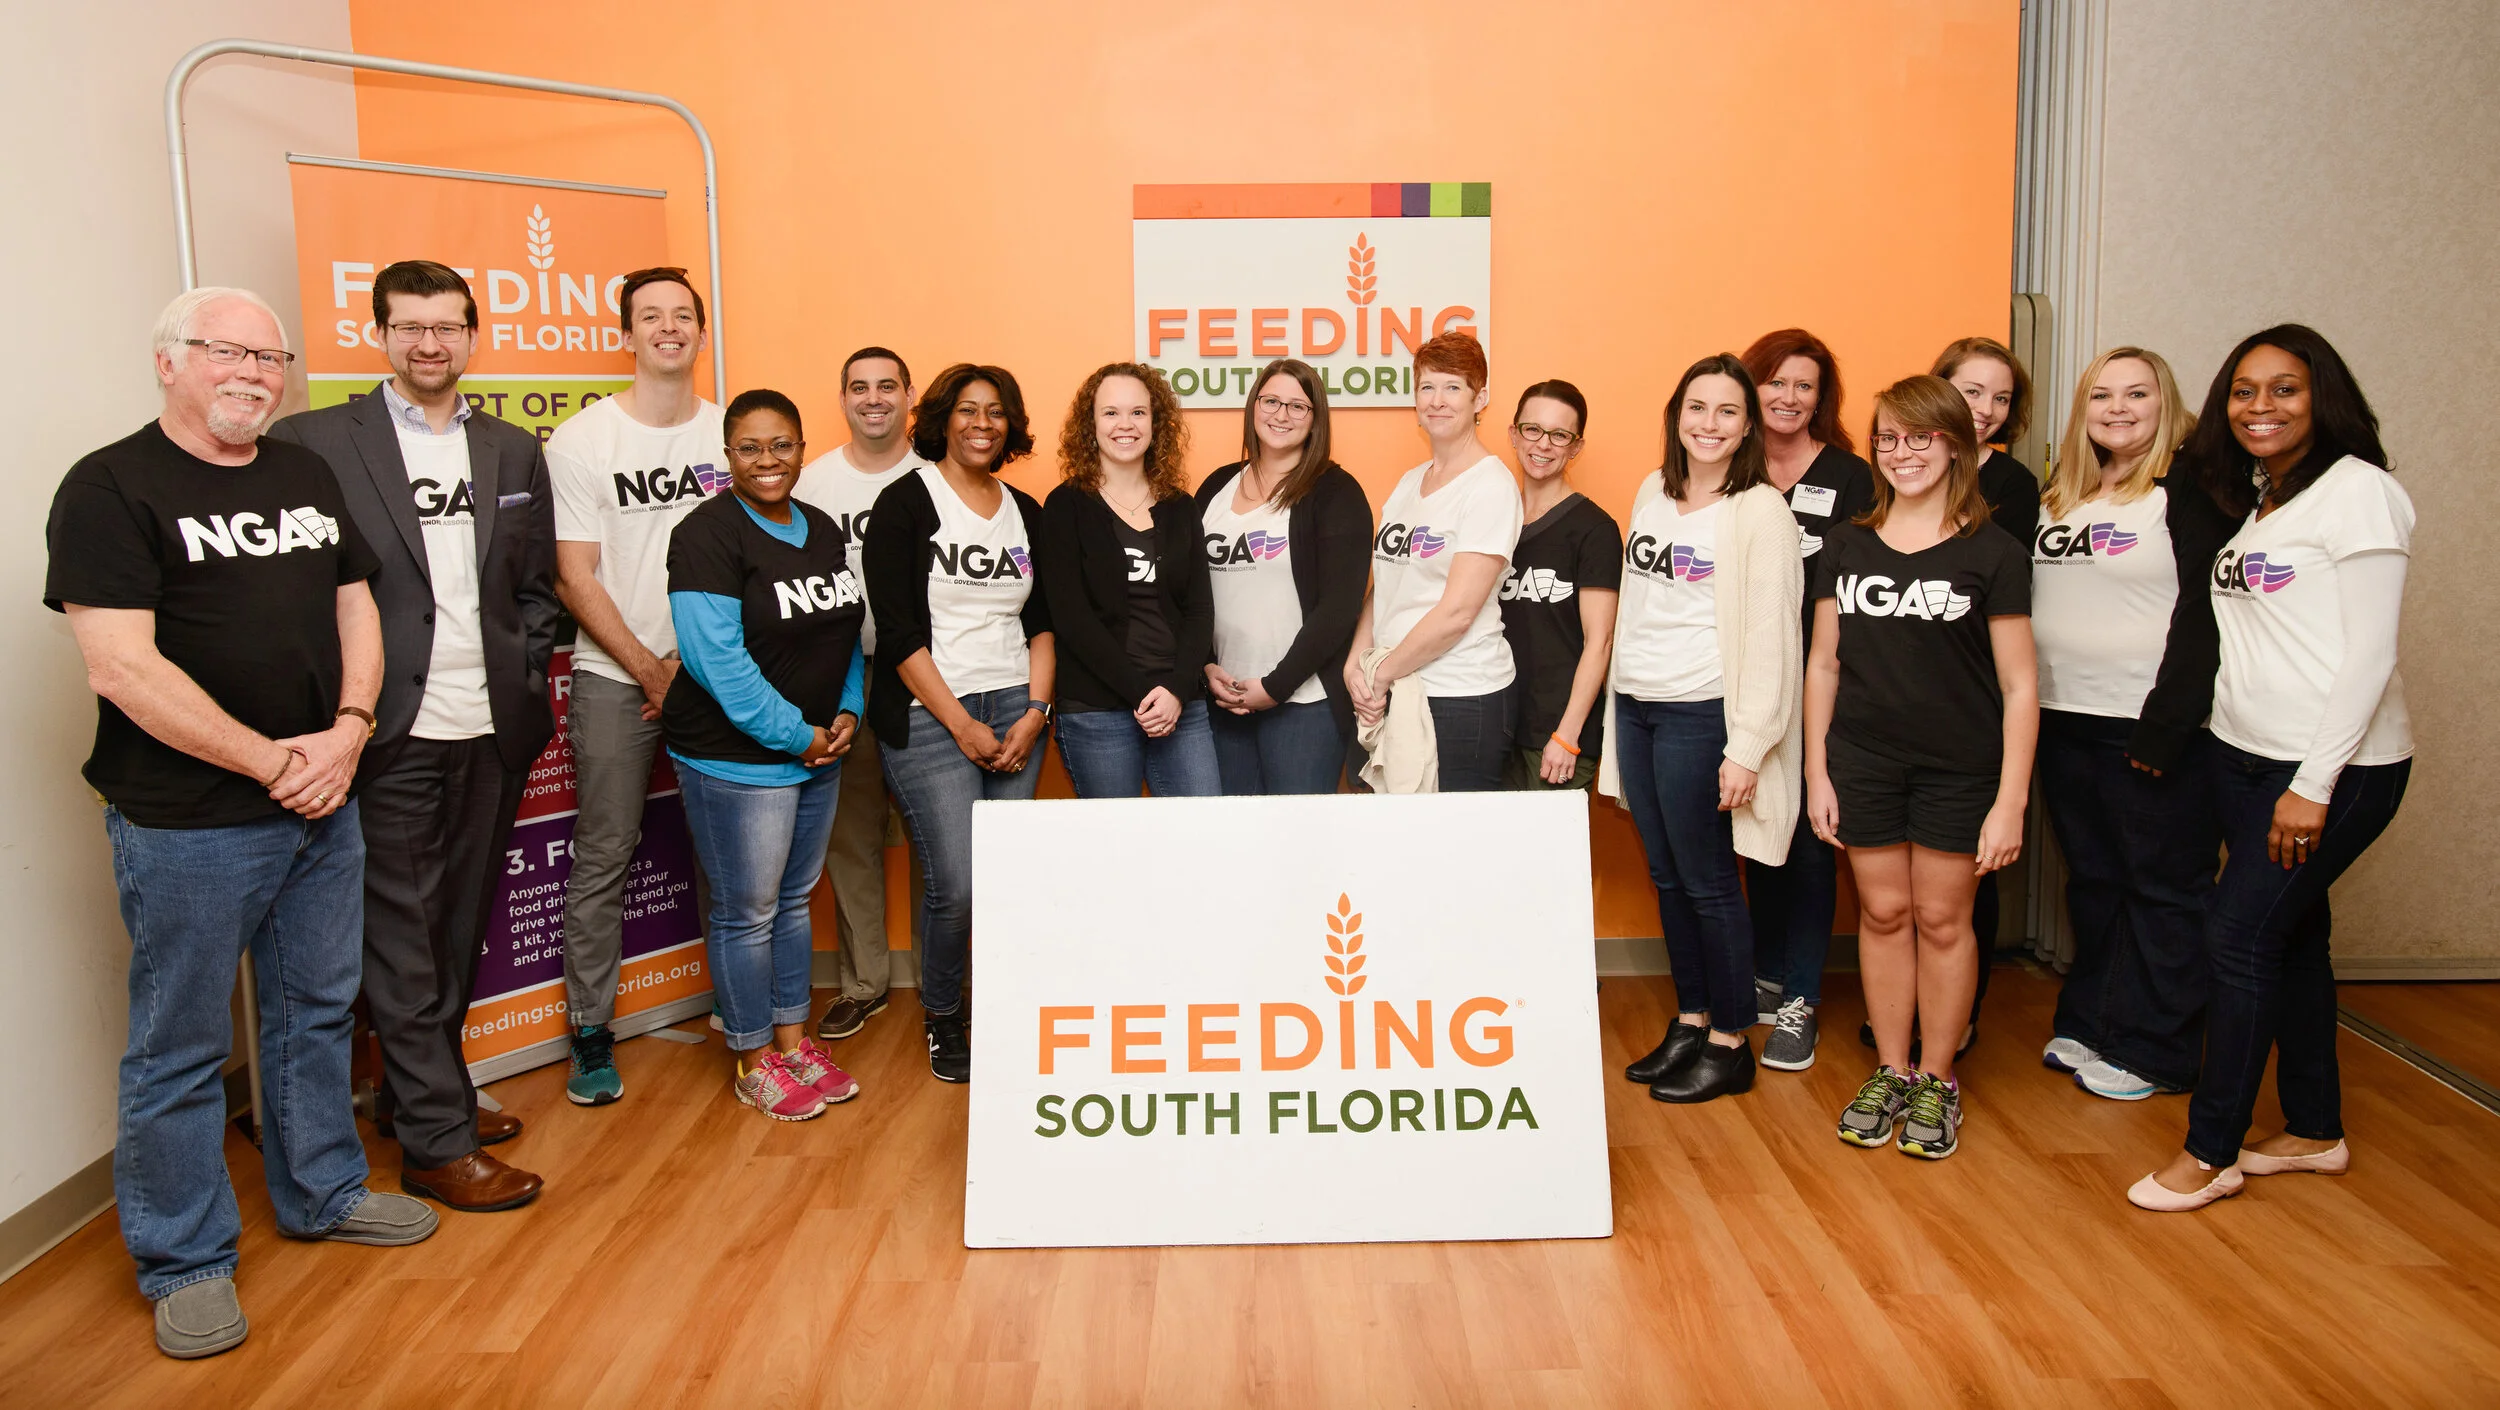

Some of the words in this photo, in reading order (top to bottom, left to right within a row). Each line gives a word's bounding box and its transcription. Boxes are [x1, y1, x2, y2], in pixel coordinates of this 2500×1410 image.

[332, 261, 626, 317] FDIN
[492, 323, 623, 352] FLORID
[1156, 368, 1264, 396] OUT
[1316, 366, 1410, 395] LORI
[522, 392, 568, 418] OF
[409, 477, 475, 518] GA
[613, 464, 706, 507] NGA
[177, 508, 322, 562] NGA
[1204, 532, 1255, 565] GA
[2032, 523, 2093, 557] GA
[928, 541, 1022, 579] NGA
[2213, 549, 2251, 592] GA
[773, 572, 859, 620] NGA
[954, 579, 988, 587] GOVERNORS
[1498, 566, 1541, 602] GA
[1836, 574, 1933, 621] NGA
[544, 749, 558, 760] or
[523, 781, 561, 799] ryone
[506, 848, 535, 876] 3.
[508, 882, 560, 902] Anyone
[645, 860, 653, 869] a
[509, 900, 541, 917] food
[642, 871, 669, 887] your
[510, 917, 545, 934] drive
[549, 911, 564, 924] wi
[635, 886, 664, 902] send
[667, 881, 688, 896] you
[512, 941, 520, 950] a
[524, 933, 545, 947] kit,
[549, 929, 564, 943] yo
[623, 907, 644, 921] the
[647, 898, 678, 915] food,
[513, 950, 540, 967] and
[1038, 996, 1514, 1075] FEEDING
[1035, 1092, 1240, 1138] SOUTH
[1269, 1087, 1539, 1135] FLORIDA
